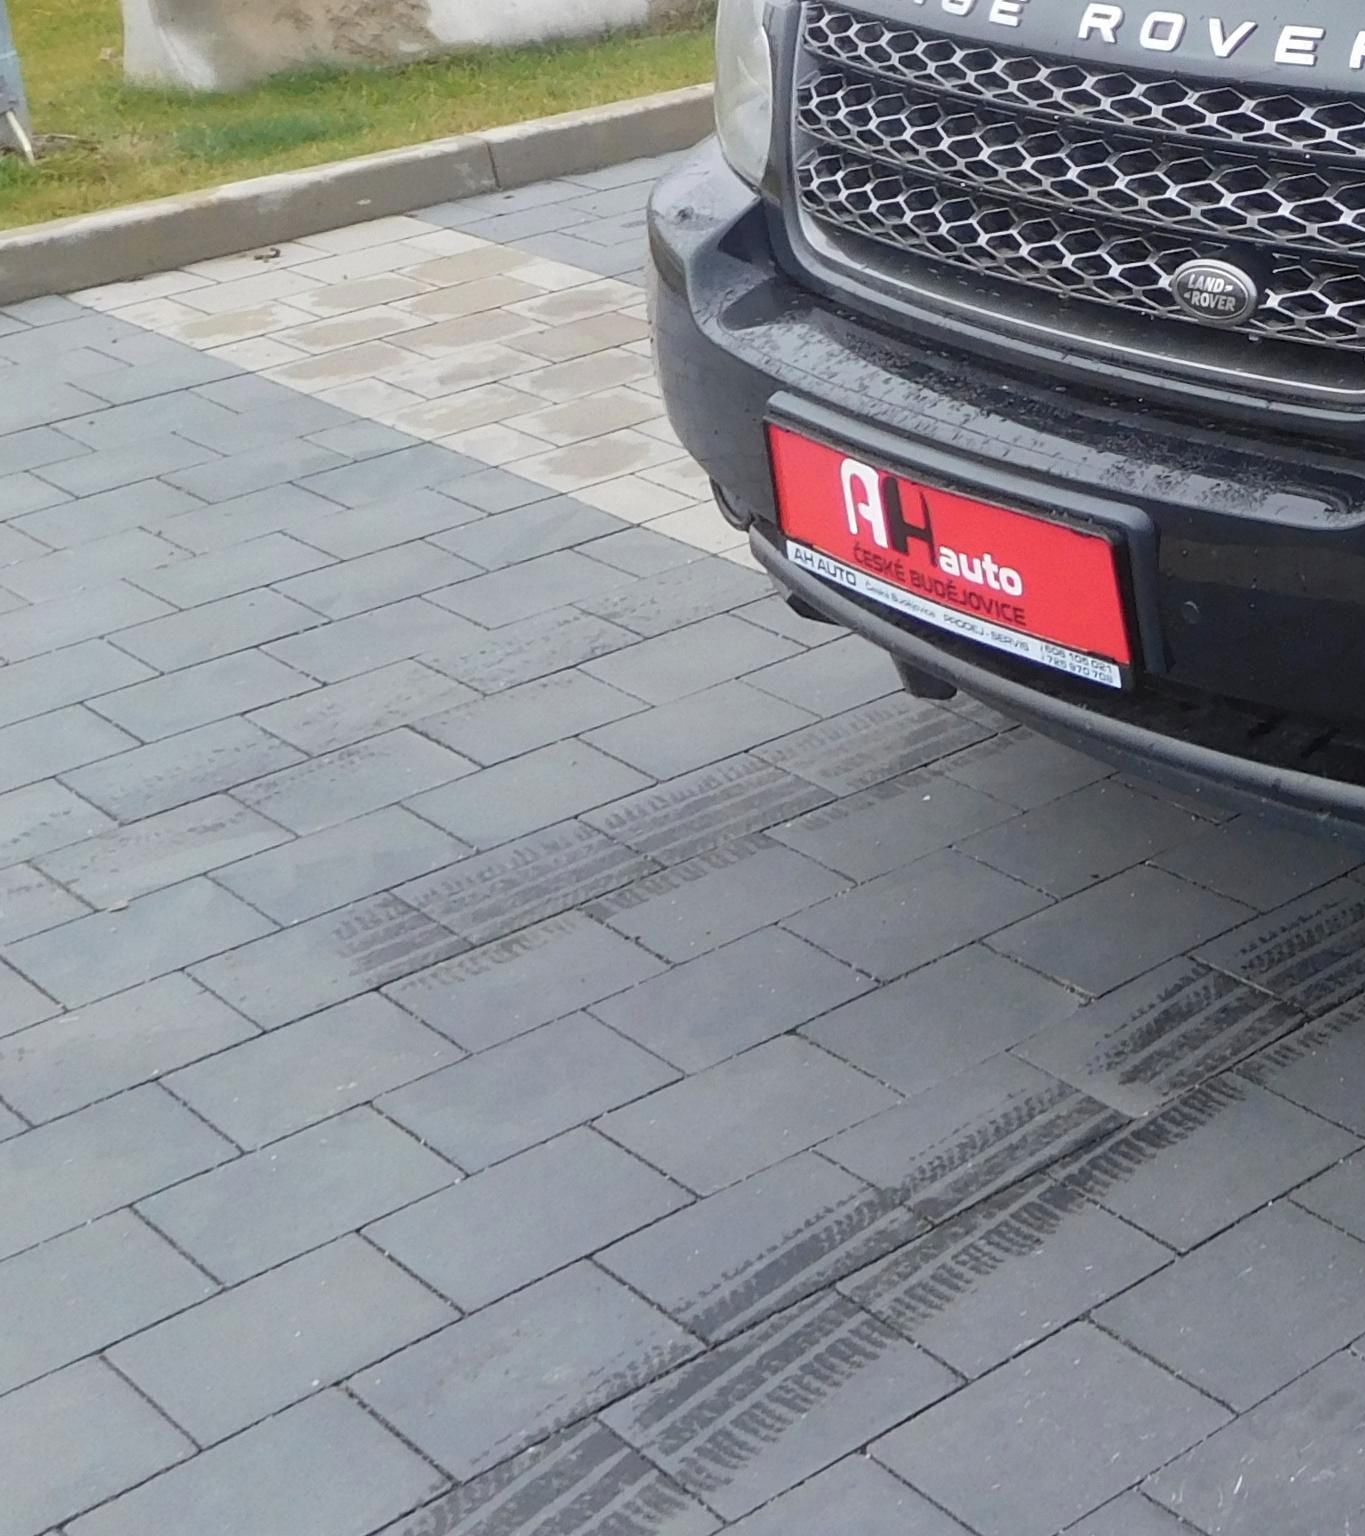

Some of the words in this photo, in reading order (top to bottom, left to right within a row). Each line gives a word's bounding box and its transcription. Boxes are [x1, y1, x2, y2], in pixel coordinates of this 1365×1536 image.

[1187, 274, 1225, 293] LAND
[1191, 291, 1236, 312] ROVER
[794, 547, 814, 565] AH
[817, 557, 857, 586] AUTO
[938, 545, 1023, 597] auto
